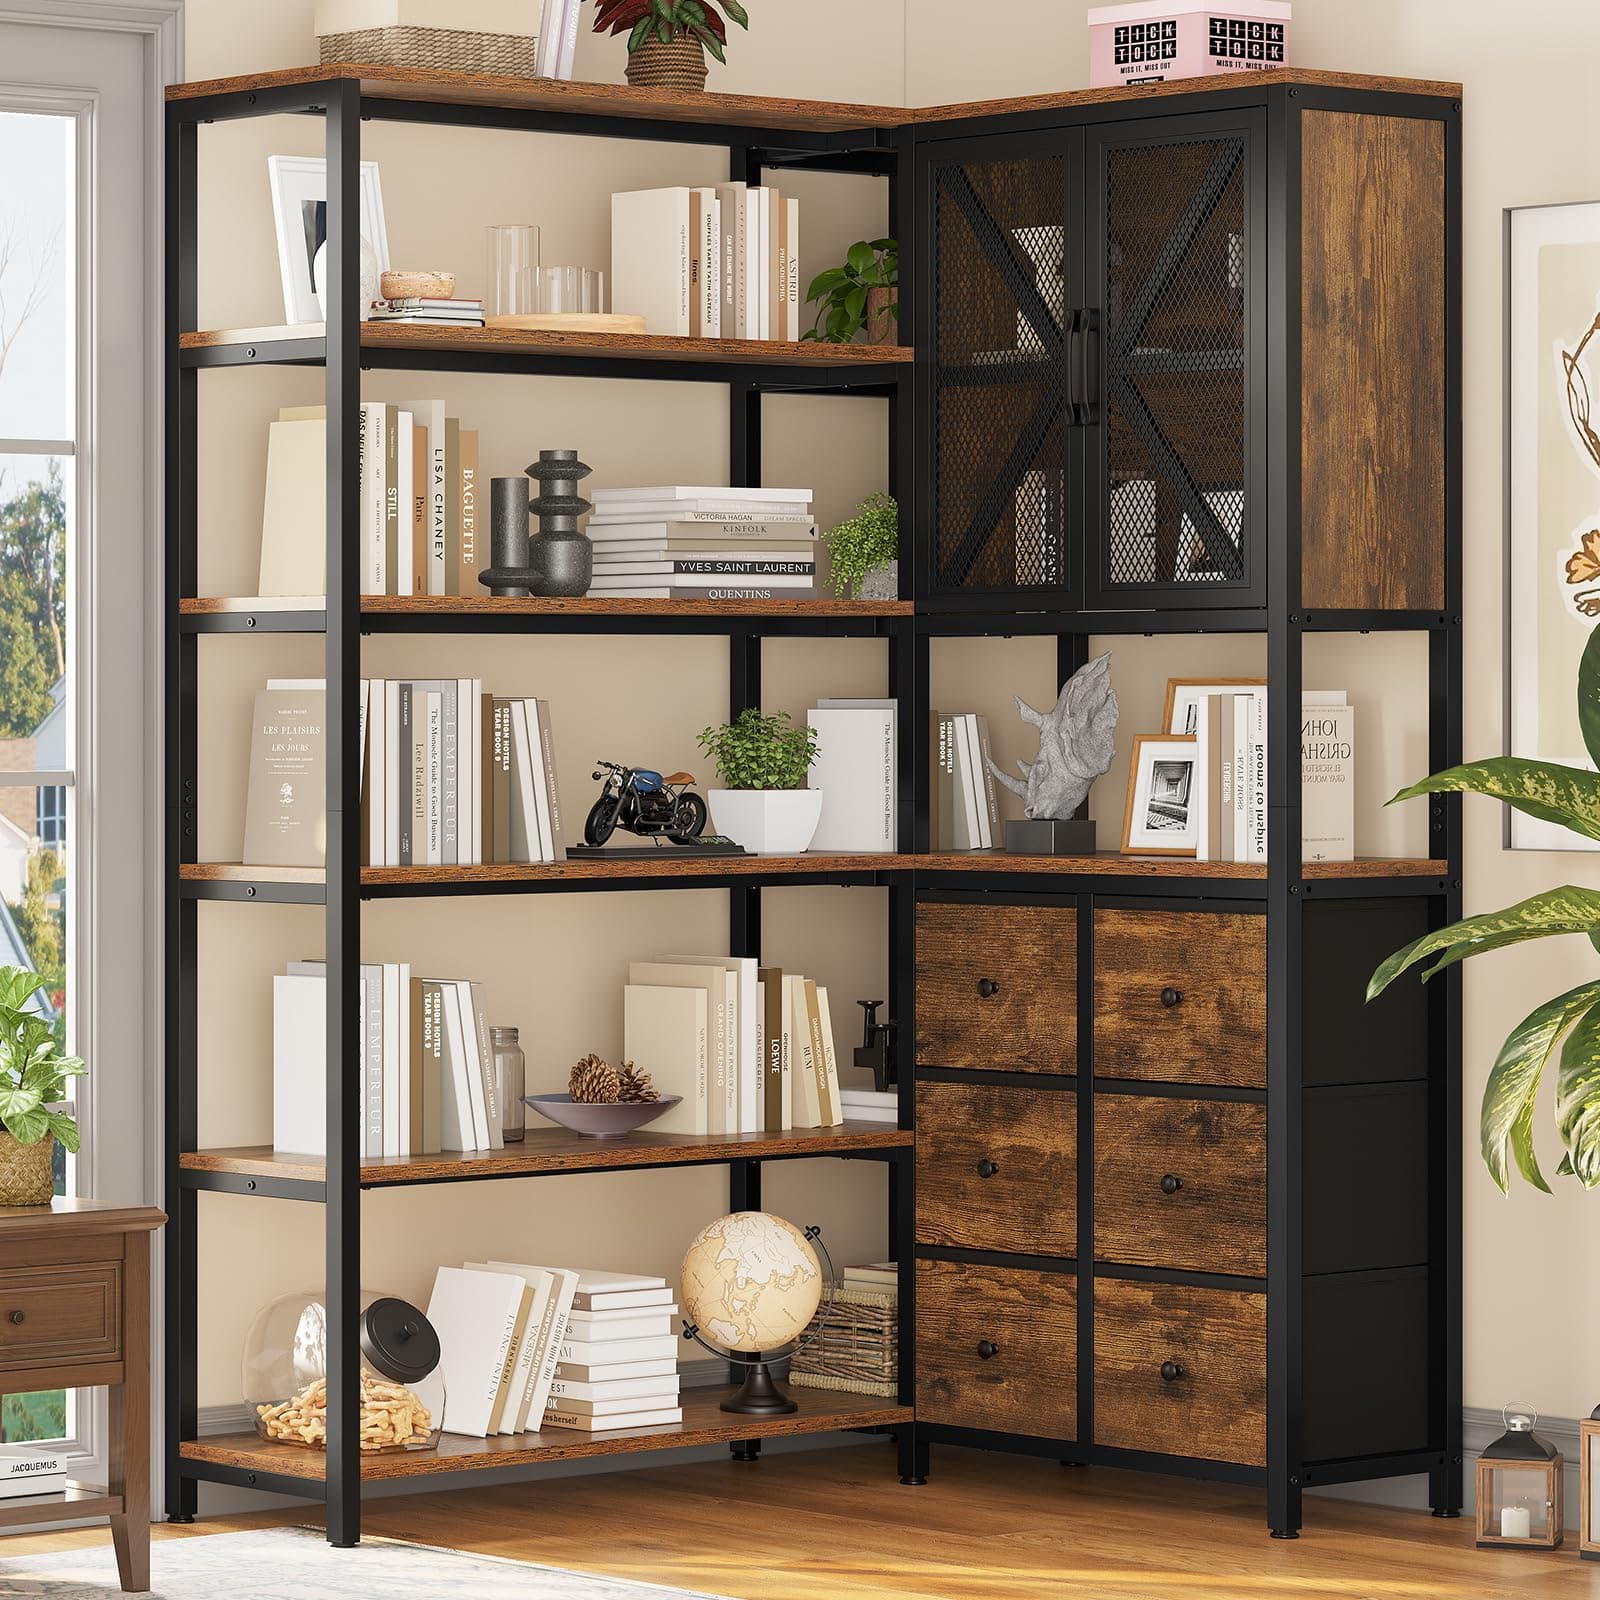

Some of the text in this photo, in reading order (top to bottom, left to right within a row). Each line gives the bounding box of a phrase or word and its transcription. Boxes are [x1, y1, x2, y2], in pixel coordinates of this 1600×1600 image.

[1119, 24, 1173, 43] TICK
[1214, 21, 1279, 40] TICK
[1119, 43, 1173, 62] TOCK
[1214, 40, 1279, 59] TOCK
[1120, 66, 1134, 74] MISS
[1144, 63, 1159, 71] MISS
[1160, 62, 1171, 70] OUT
[1216, 59, 1233, 68] MISS
[789, 257, 797, 302] ASTRID
[388, 487, 397, 521] STILL
[415, 496, 424, 523] Paris
[435, 448, 443, 561] LISA CHANEY
[463, 468, 474, 564] BAGUETTE
[693, 513, 727, 521] VICTORIA
[723, 525, 767, 534] KINFOLK
[680, 563, 811, 573] YVES SAINT LAURENT
[708, 590, 771, 600] QUENTINS
[431, 709, 439, 724] The
[263, 726, 321, 735] LES PLAISIRS
[431, 726, 439, 759] Monocle
[416, 743, 425, 818] Lee Radziwill
[431, 761, 439, 784] Guide
[446, 721, 456, 843] LEMPEREUR
[431, 796, 439, 817] Good
[431, 819, 439, 851] Business
[771, 1039, 780, 1074] LOEWE
[371, 1009, 381, 1136] LEMPEREUR
[525, 1299, 556, 1402] MERINGUES MACARONS
[543, 1365, 554, 1381] THE
[553, 1311, 567, 1343] JUSTICE
[551, 1383, 566, 1393] EST
[553, 1413, 578, 1425] herself
[11, 1461, 57, 1473] JACQUEMUS
